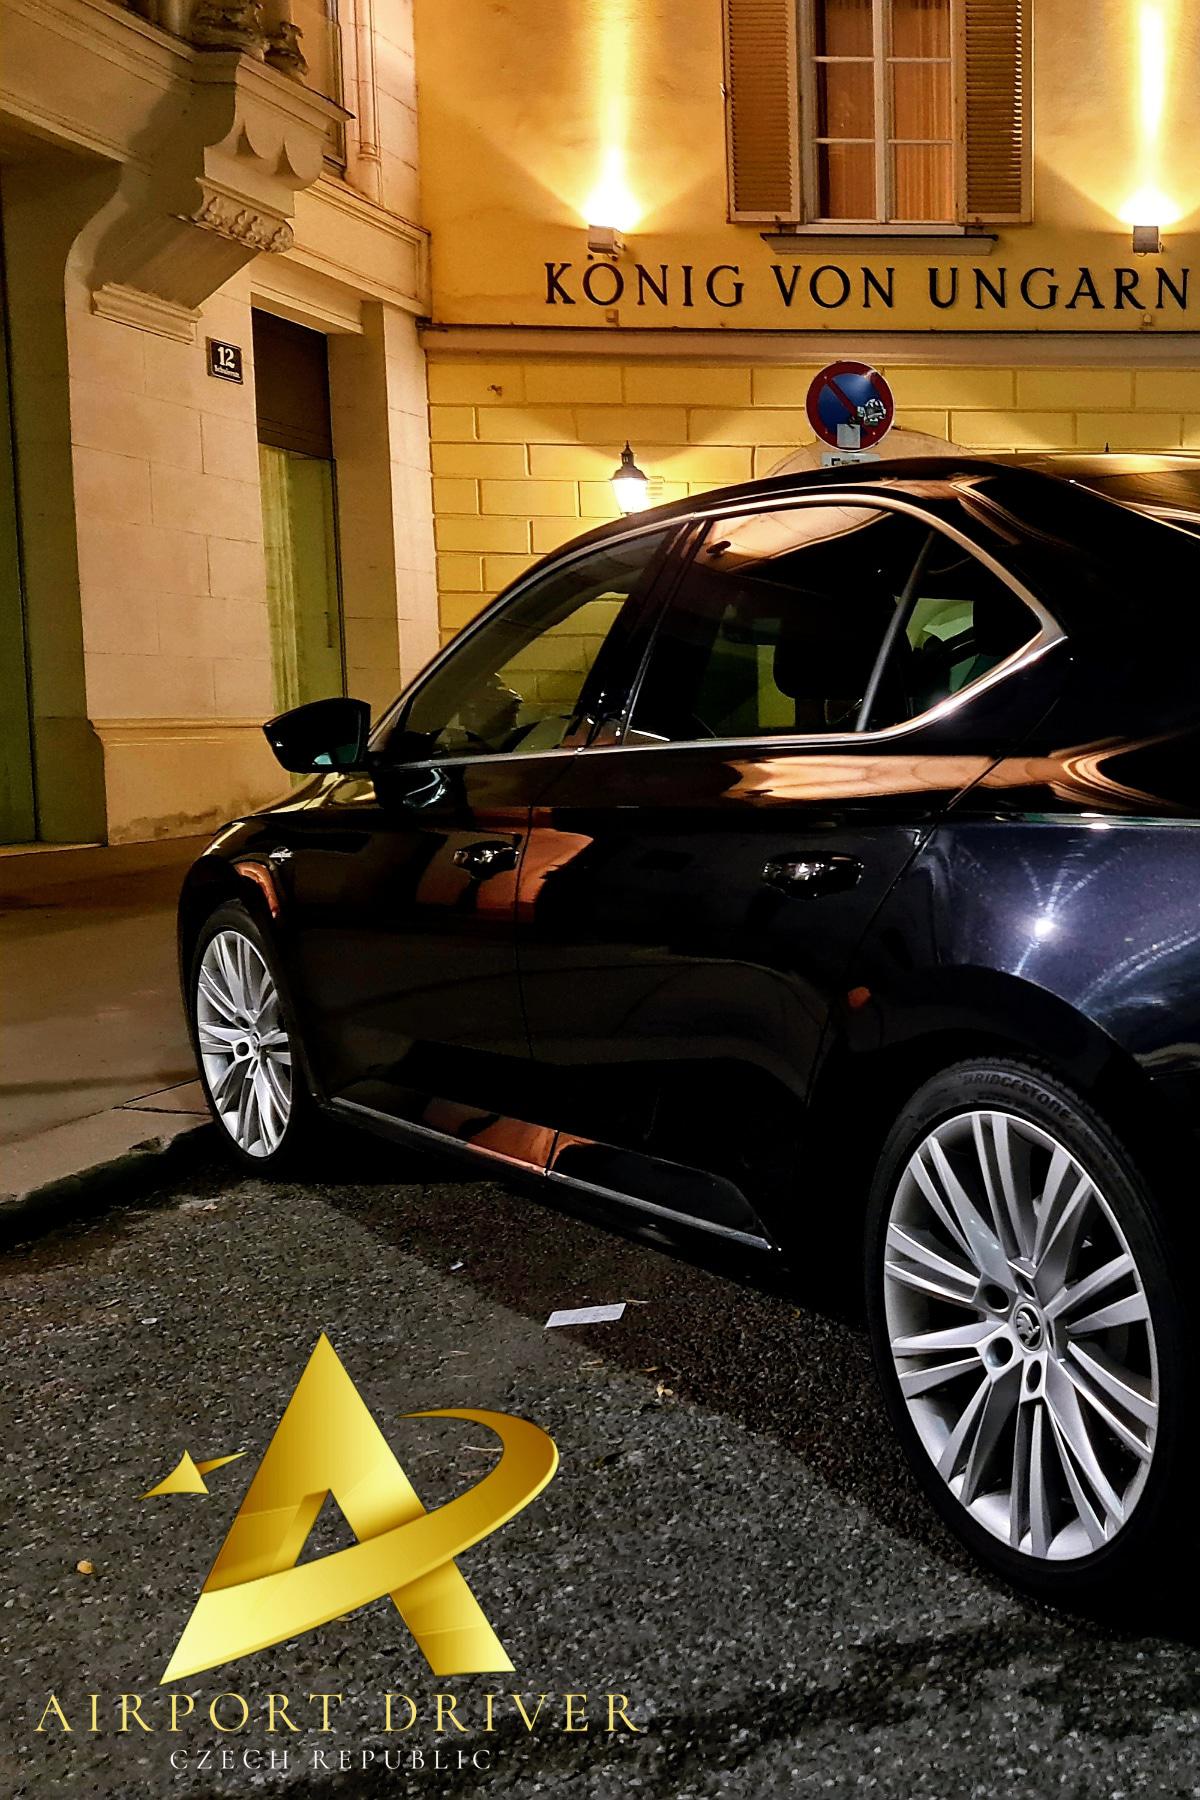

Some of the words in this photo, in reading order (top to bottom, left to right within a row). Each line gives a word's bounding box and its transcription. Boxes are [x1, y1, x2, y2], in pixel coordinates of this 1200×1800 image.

[544, 255, 744, 308] KÖNIG
[772, 265, 896, 309] VON
[929, 267, 1190, 311] UNGARN
[217, 346, 236, 369] 12
[962, 1072, 1074, 1120] BRIDGESTONE
